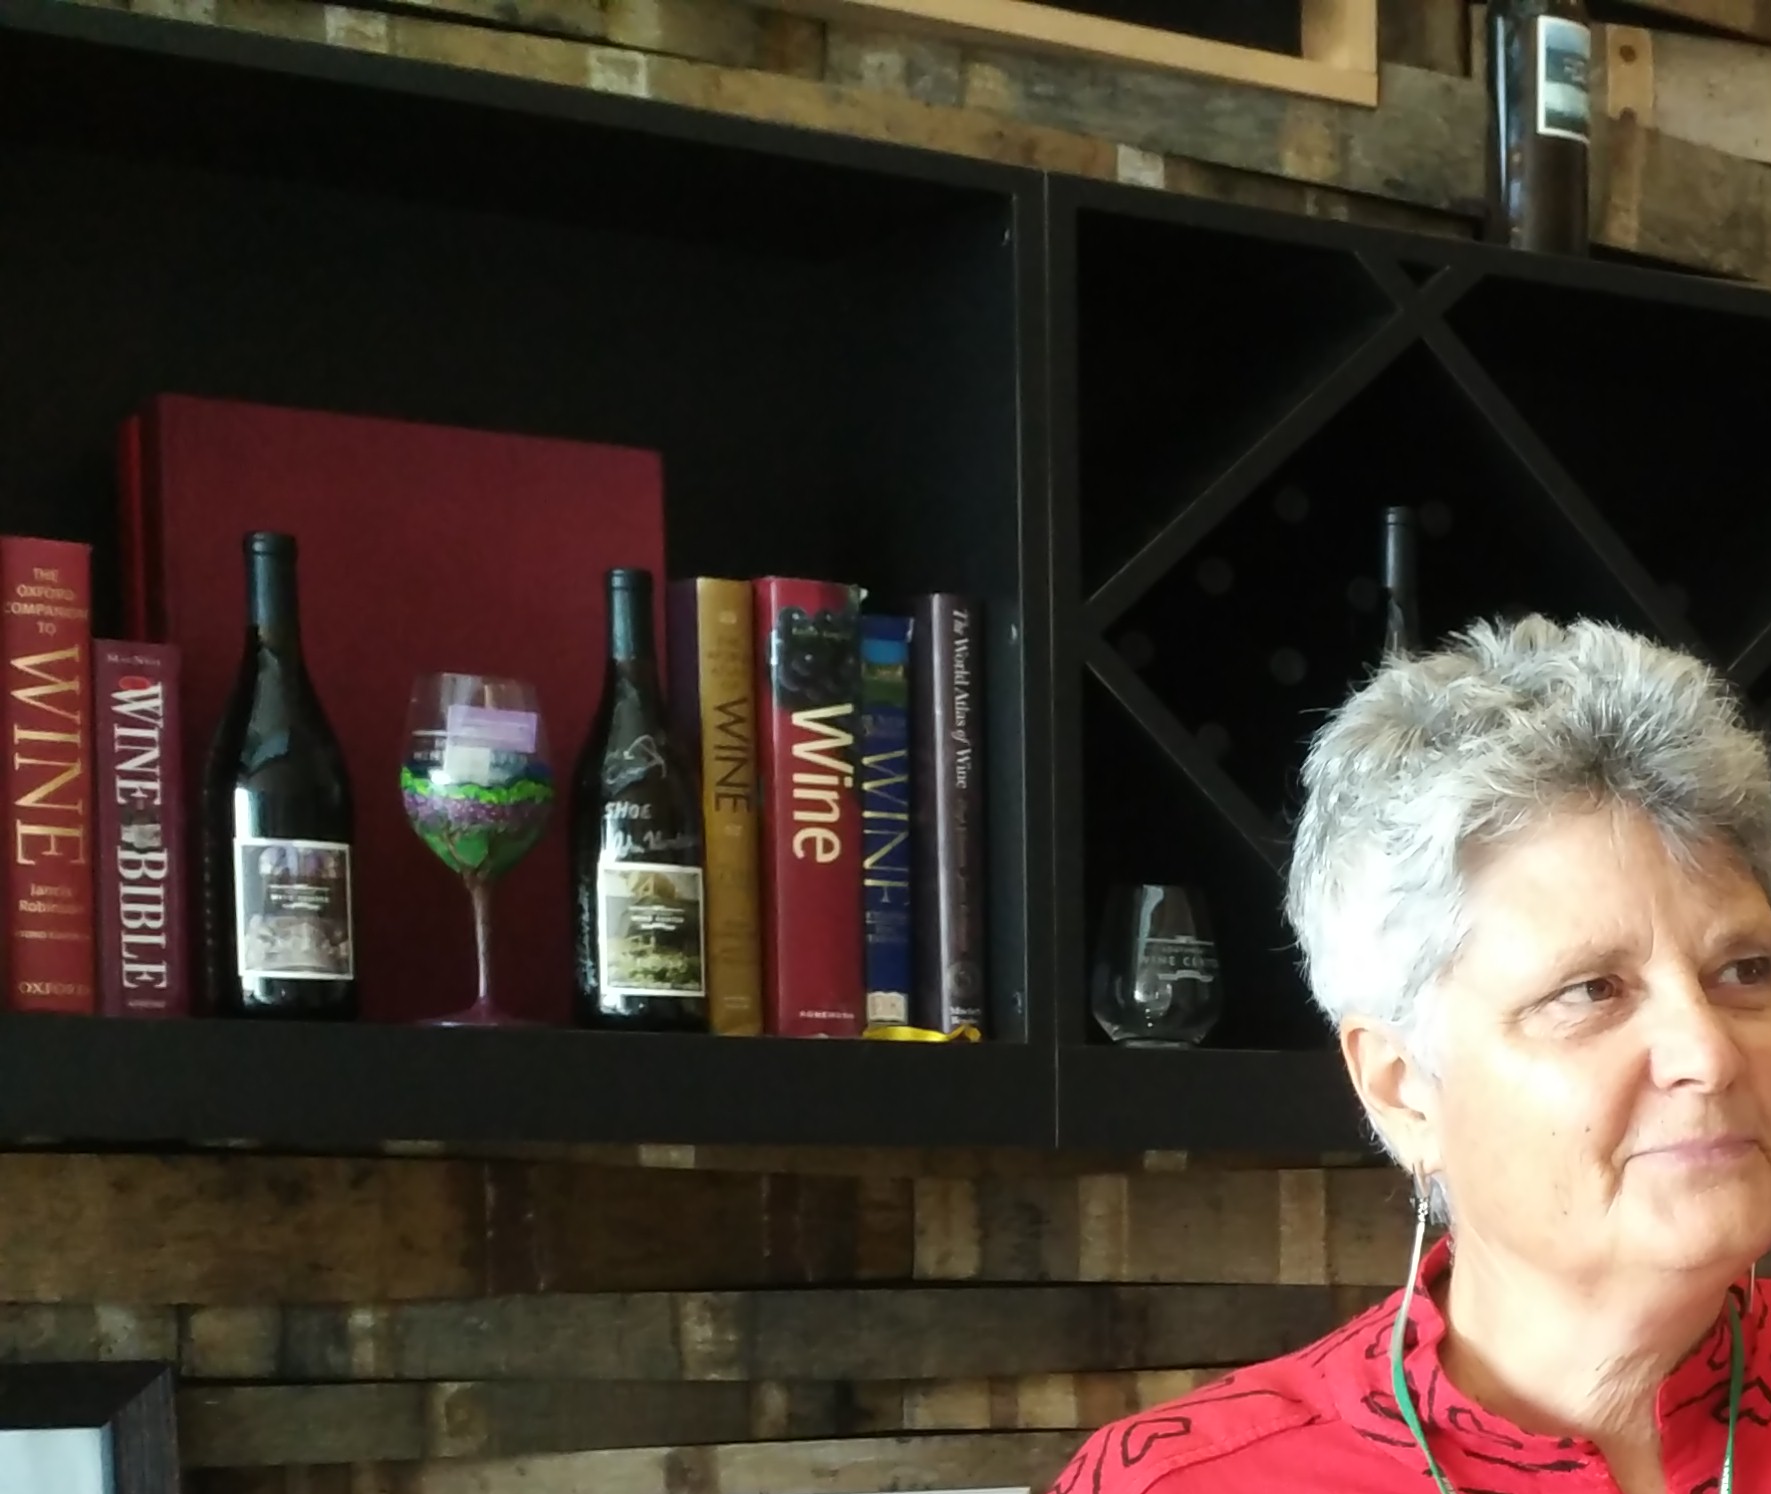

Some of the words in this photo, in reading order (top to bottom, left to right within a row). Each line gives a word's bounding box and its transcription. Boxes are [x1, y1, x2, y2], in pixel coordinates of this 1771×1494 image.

[16, 584, 75, 600] OXFORD
[33, 568, 58, 582] THE
[37, 622, 57, 636] TO
[952, 608, 971, 636] The
[952, 637, 971, 685] World
[953, 686, 971, 727] Atlas
[10, 644, 82, 864] WINE
[110, 681, 164, 806] WINE
[713, 697, 750, 813] WINE
[950, 728, 973, 746] of
[792, 703, 854, 863] Wine
[953, 747, 973, 789] Wine
[604, 801, 652, 819] SHOE
[862, 749, 909, 906] WINE
[117, 845, 169, 988] BIBLE
